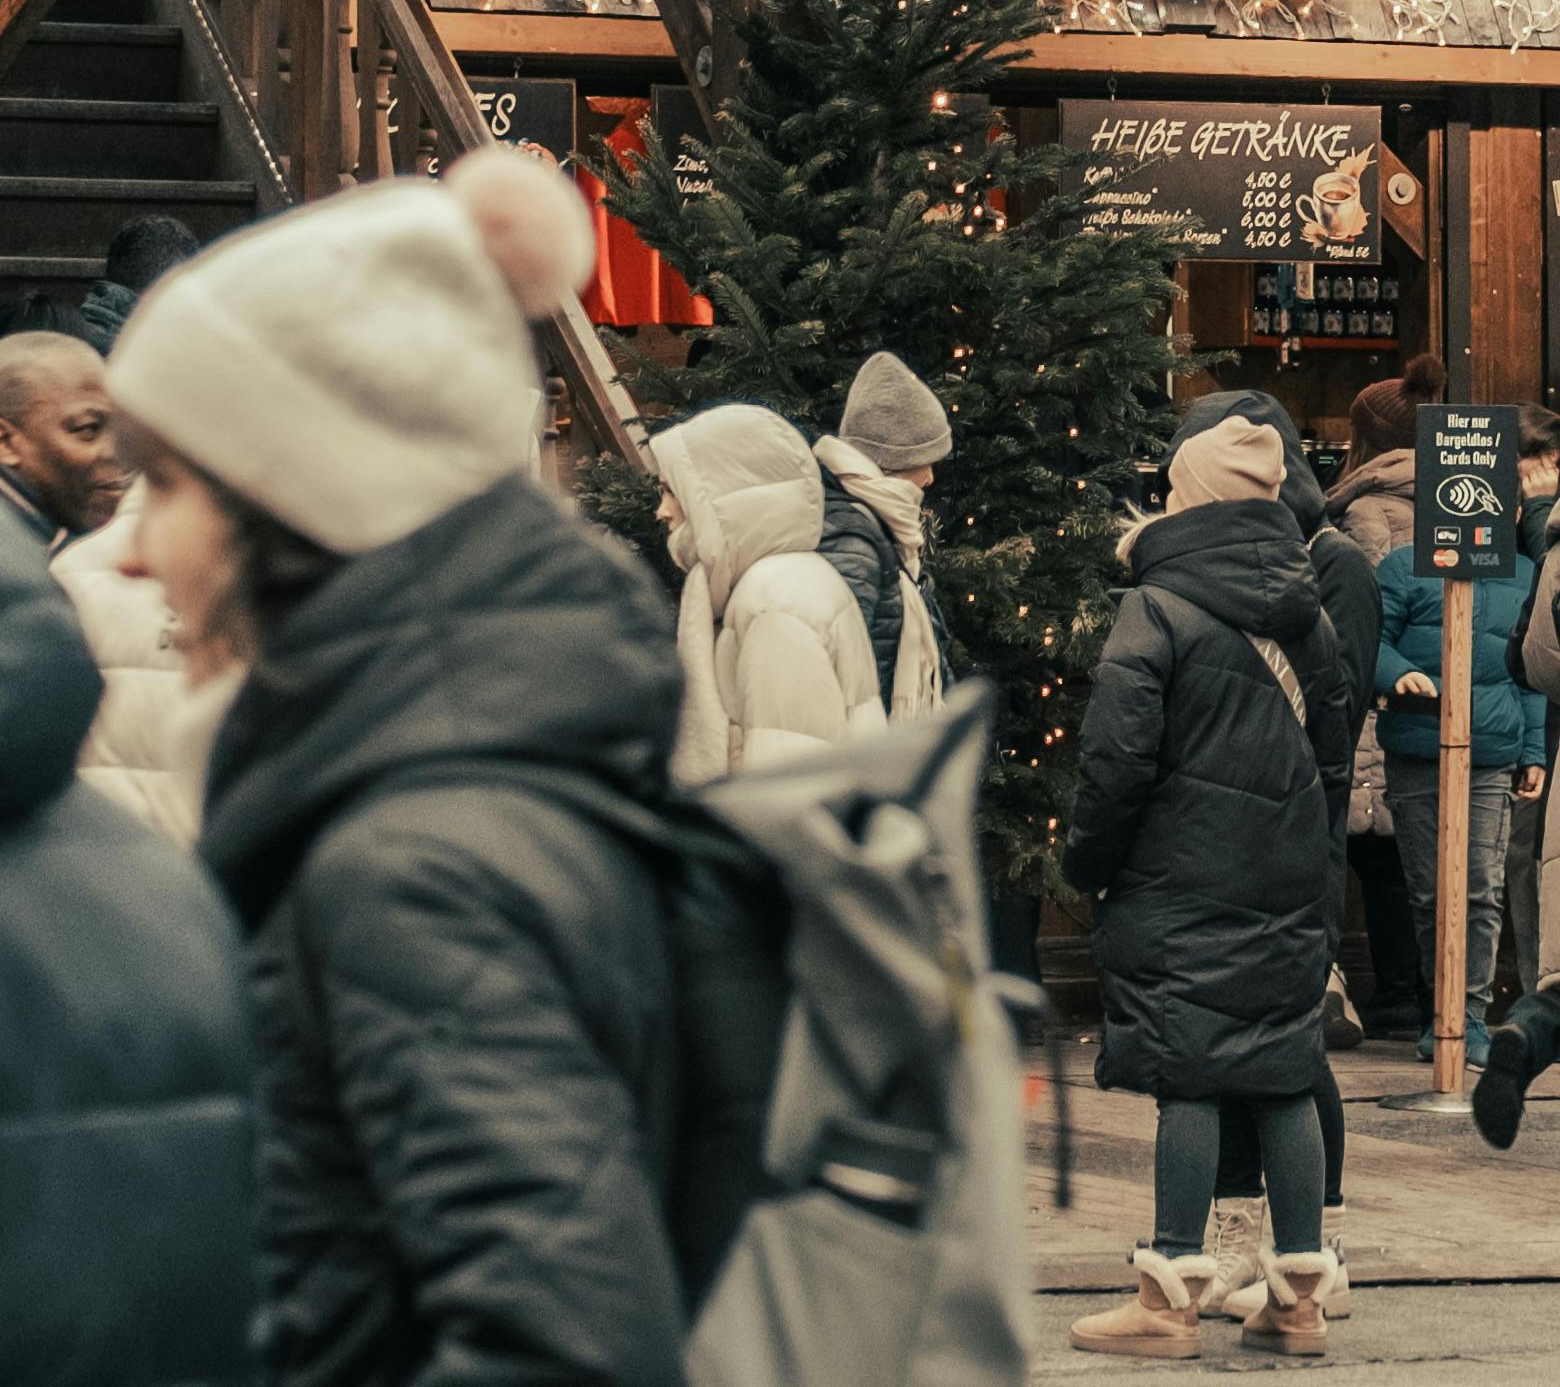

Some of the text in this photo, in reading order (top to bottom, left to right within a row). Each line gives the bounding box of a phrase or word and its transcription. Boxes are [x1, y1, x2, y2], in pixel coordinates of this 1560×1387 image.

[1190, 110, 1352, 166] GETRÄNKE
[1244, 171, 1277, 189] 4,50
[1242, 191, 1277, 210] 5,00
[1241, 210, 1277, 229] 6,00
[1244, 230, 1277, 248] 4,50
[1447, 413, 1491, 429] Hier nur
[1435, 432, 1494, 450] Bargeldlos
[1440, 450, 1497, 469] Cards Only
[1468, 552, 1500, 566] VISA
